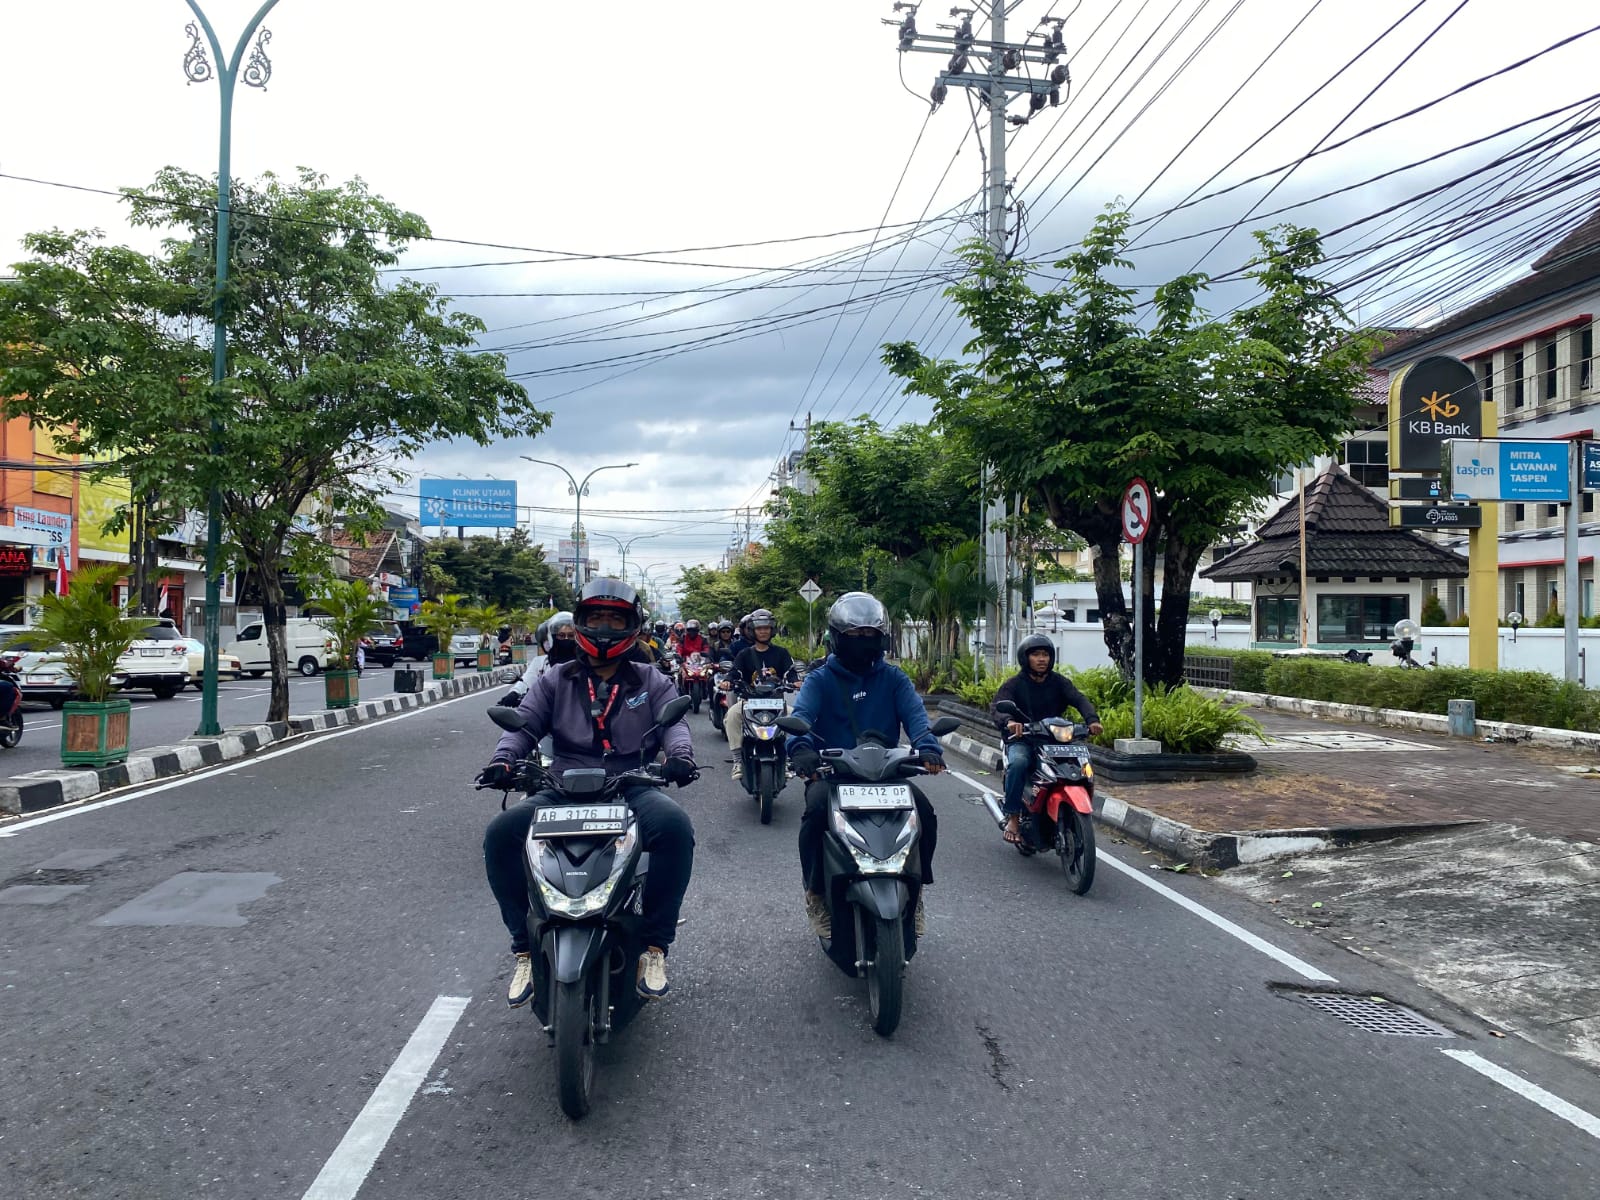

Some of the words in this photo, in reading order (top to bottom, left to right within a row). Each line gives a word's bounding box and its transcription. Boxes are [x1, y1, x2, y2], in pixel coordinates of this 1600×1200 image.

[1409, 421, 1430, 433] KB
[1434, 422, 1471, 435] Bank
[1510, 451, 1541, 460] MITRA
[1456, 465, 1494, 477] taspen
[1510, 463, 1557, 471] LAYANAN
[1510, 474, 1548, 483] TASPEN
[452, 488, 480, 496] KLINIK
[482, 488, 511, 497] UTAMA
[37, 512, 67, 529] Laundry
[842, 787, 855, 796] AB
[861, 787, 887, 796] 2412
[541, 811, 556, 821] AB
[566, 809, 598, 820] 3176
[608, 808, 621, 819] IL
